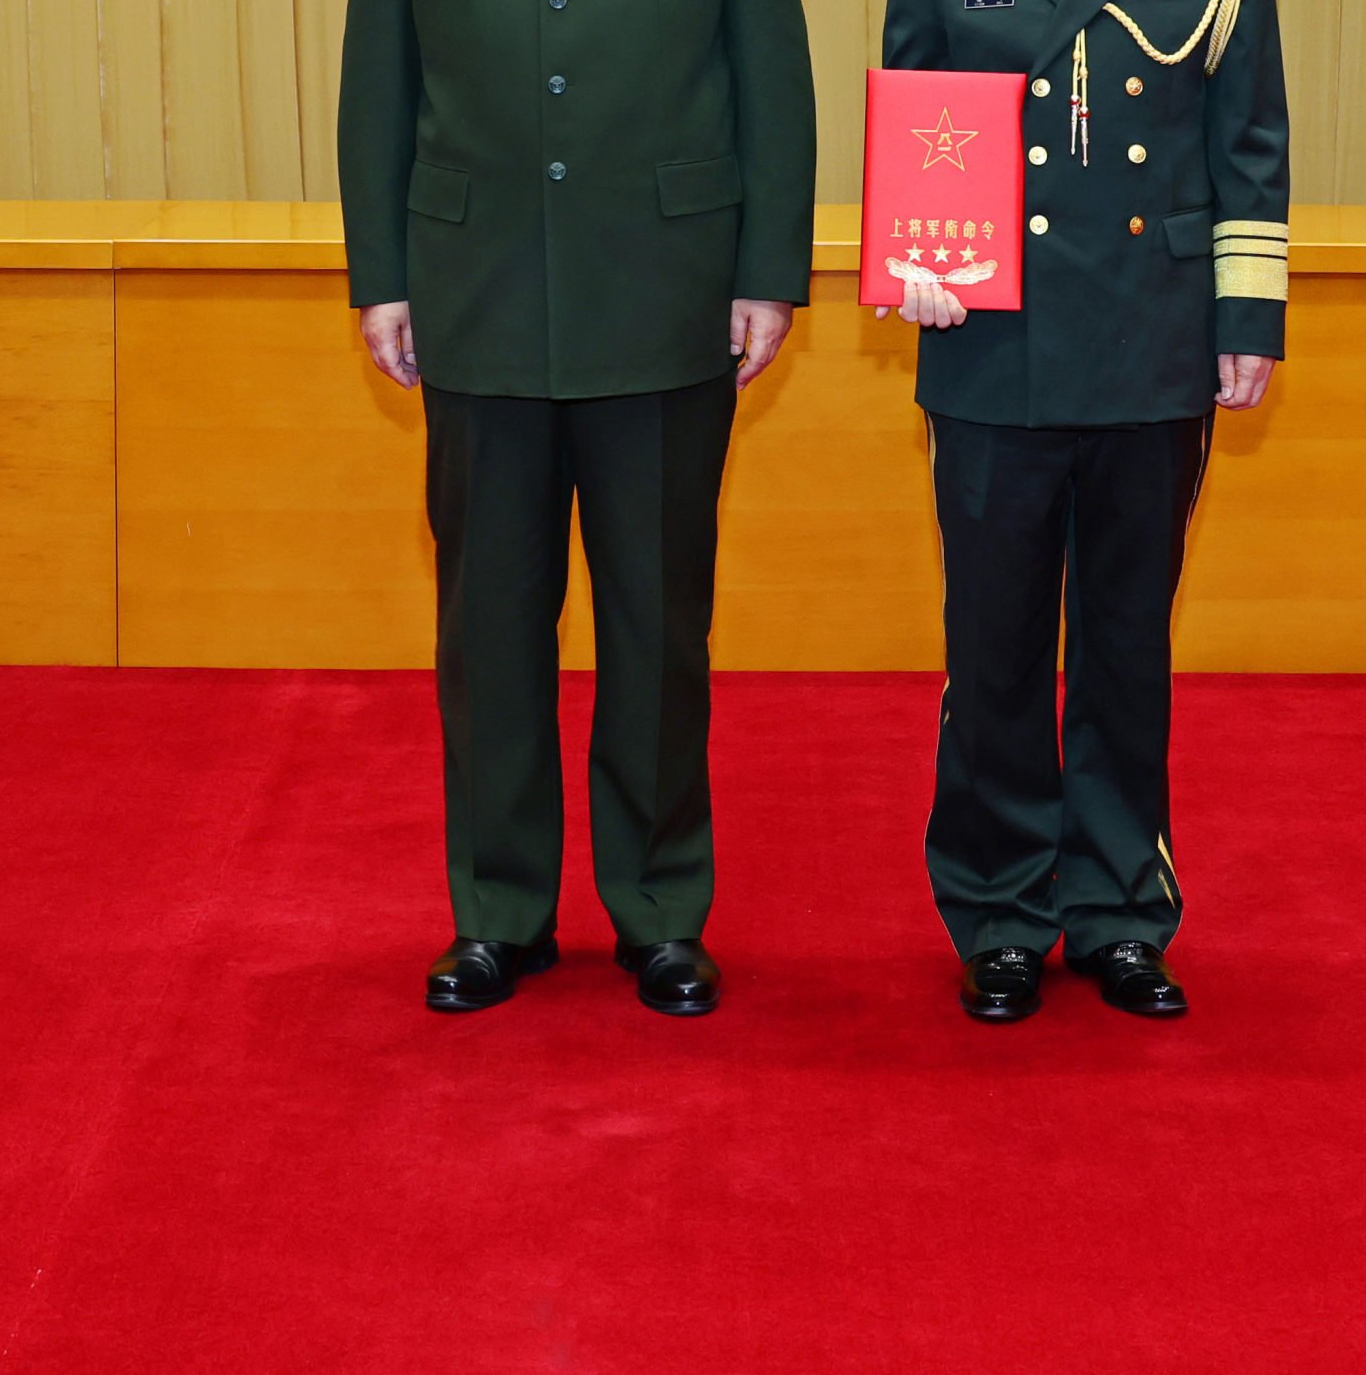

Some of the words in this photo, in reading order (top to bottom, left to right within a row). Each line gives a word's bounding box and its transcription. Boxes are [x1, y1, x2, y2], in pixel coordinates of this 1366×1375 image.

[889, 217, 996, 240] 上将军衔命令
